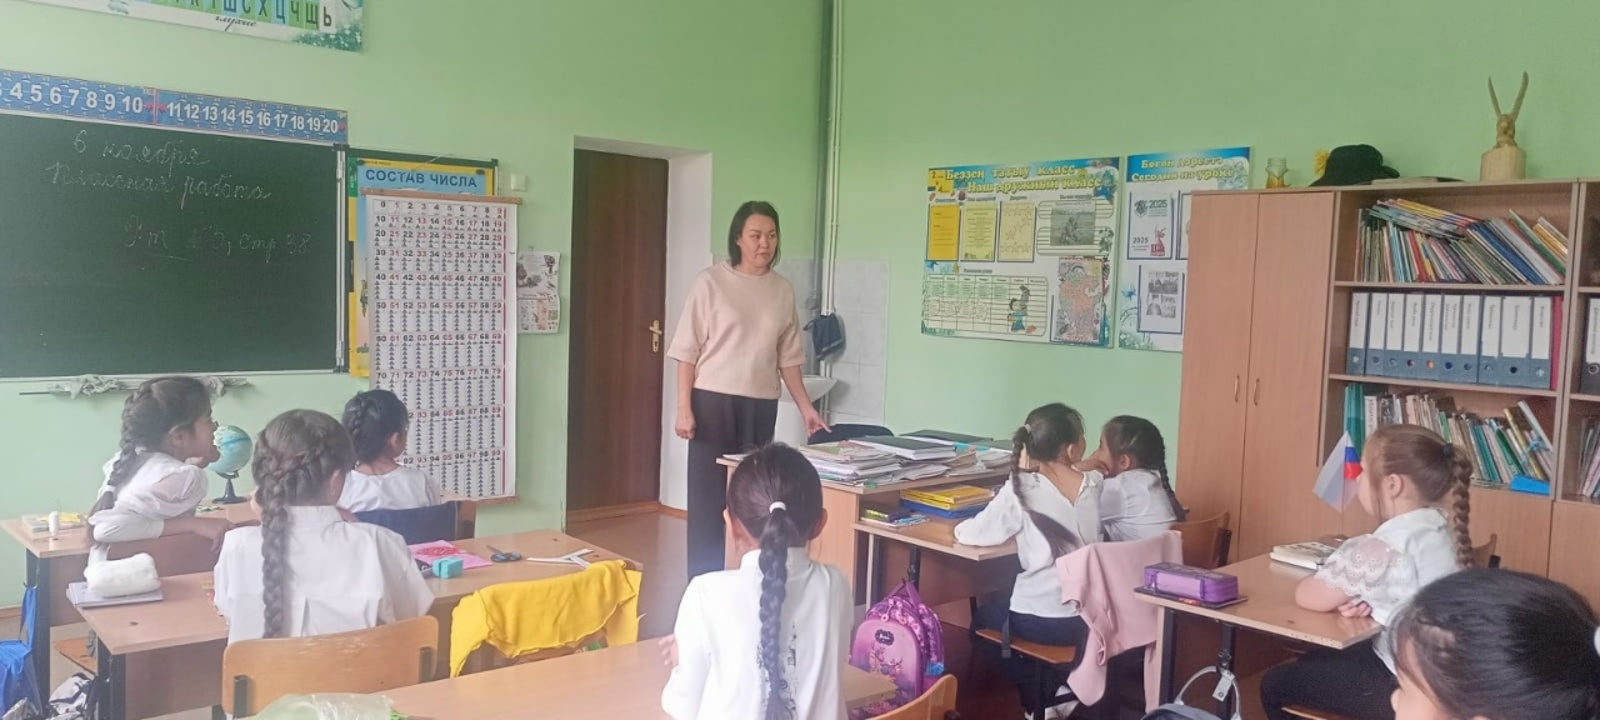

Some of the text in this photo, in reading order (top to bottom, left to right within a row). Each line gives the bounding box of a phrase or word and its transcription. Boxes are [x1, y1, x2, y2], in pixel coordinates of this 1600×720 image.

[275, 0, 286, 24] Ц
[305, 3, 320, 31] Щ
[323, 6, 332, 27] Ь
[10, 83, 23, 99] 4
[31, 84, 42, 102] 5
[50, 87, 62, 104] 6
[68, 89, 79, 106] 7
[87, 91, 97, 108] 8
[104, 94, 115, 111] 9
[122, 96, 143, 113] 10
[167, 102, 338, 133] 11 12 13 14 15 16 17 18 19 20
[73, 129, 211, 178] 6 ноября
[366, 169, 425, 184] СОСТАВ
[430, 173, 478, 188] ЧИСЛА
[1037, 164, 1076, 176] класс
[1131, 172, 1178, 182] Сегодня
[1198, 169, 1234, 181] уроке
[180, 174, 272, 209] работа
[968, 178, 1102, 194] Наш дружный класс
[1149, 199, 1168, 208] 2025
